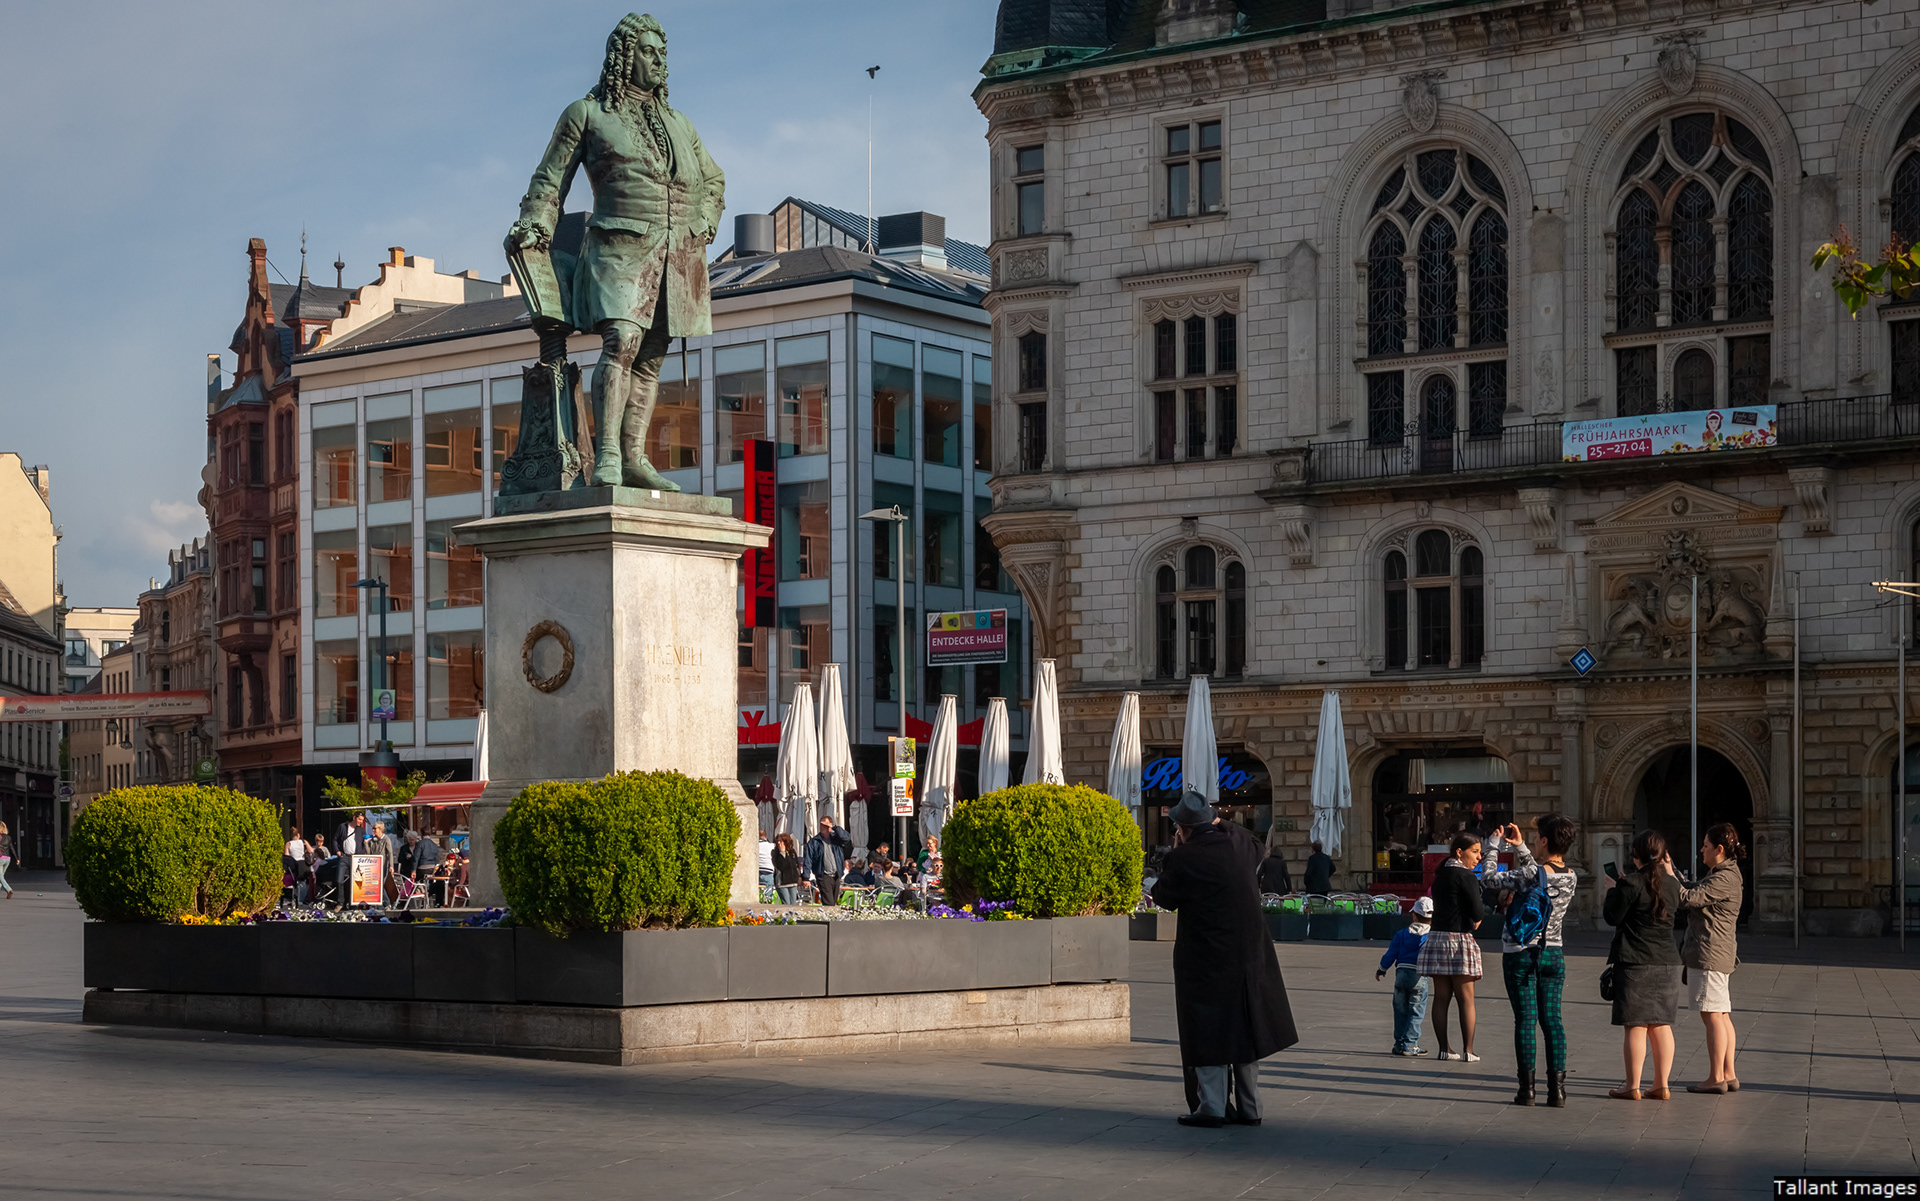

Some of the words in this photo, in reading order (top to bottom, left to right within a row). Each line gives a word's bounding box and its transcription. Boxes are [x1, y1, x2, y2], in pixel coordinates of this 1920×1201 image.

[1571, 421, 1613, 431] HALLESCHER
[1571, 424, 1688, 443] FRÜHJAHRSMARKT
[932, 636, 974, 646] ENTDECKE
[976, 634, 1004, 644] HALLE!
[1141, 757, 1254, 791] Rito
[1831, 797, 1837, 808] 2
